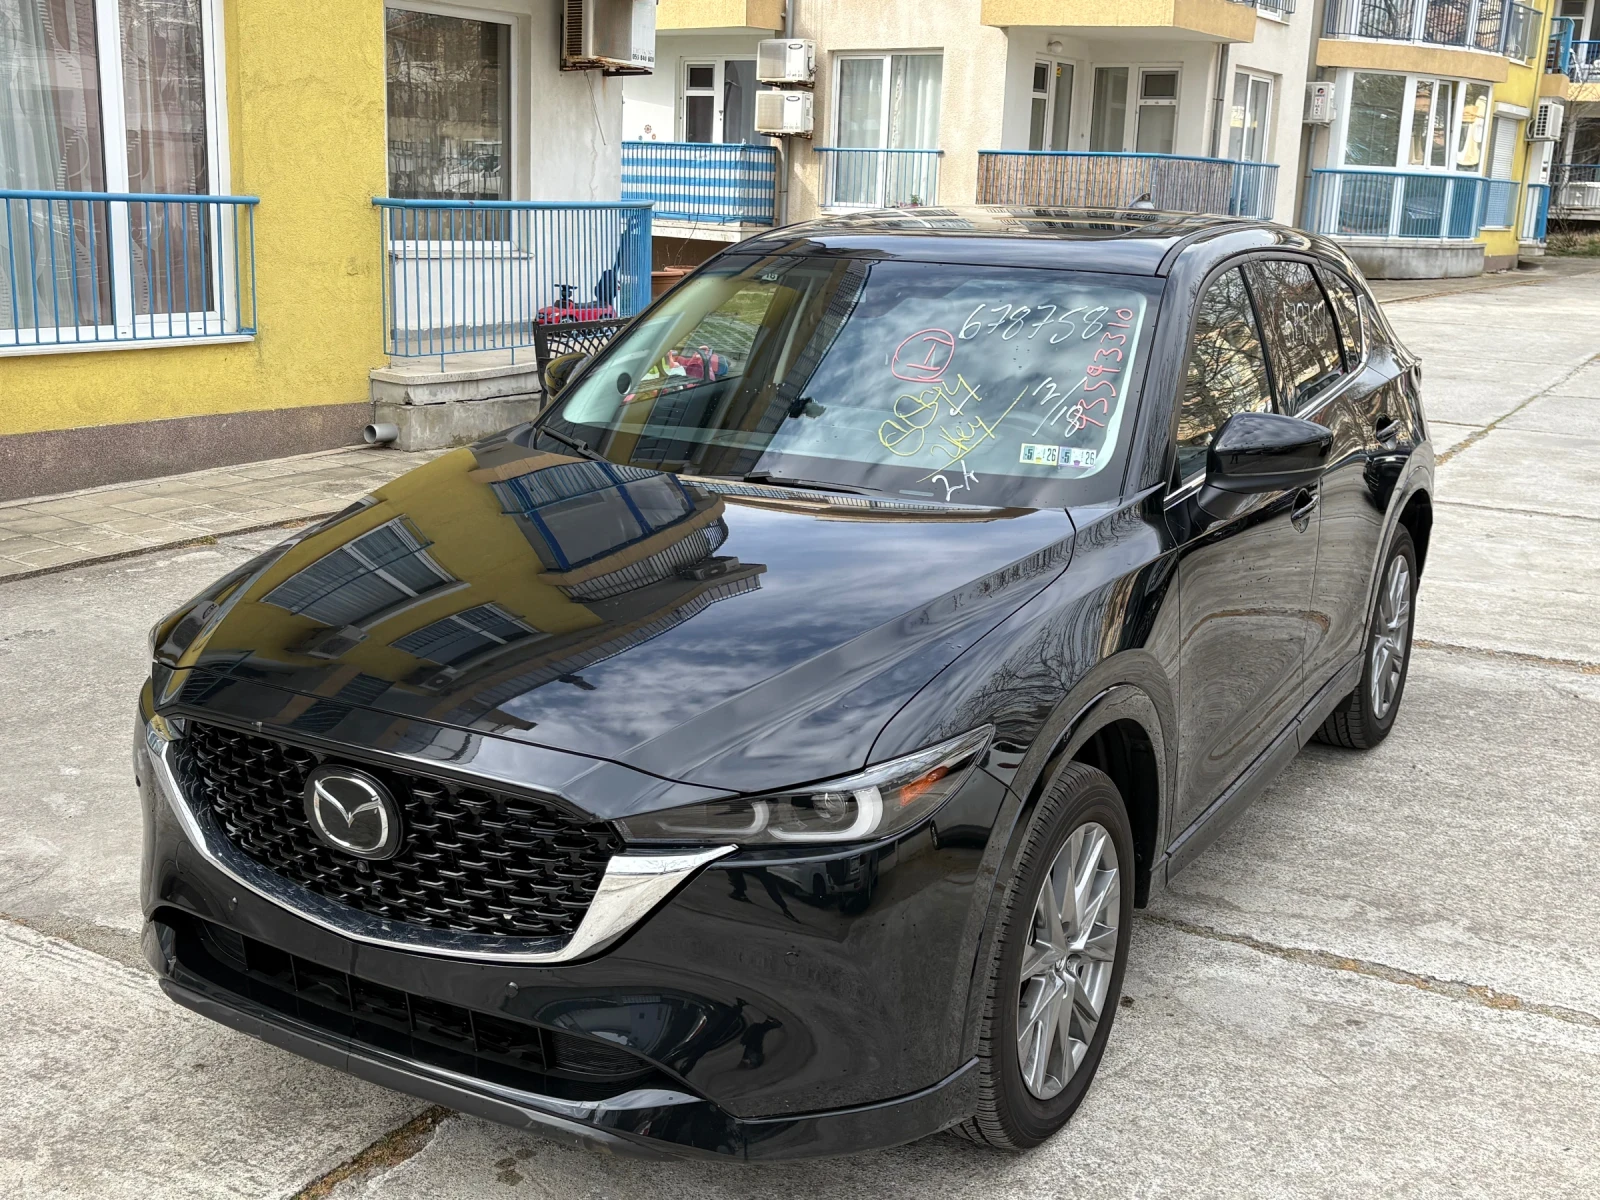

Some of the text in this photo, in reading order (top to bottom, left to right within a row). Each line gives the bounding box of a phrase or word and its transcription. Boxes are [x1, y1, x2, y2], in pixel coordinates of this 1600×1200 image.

[958, 303, 1109, 344] 678758
[1046, 447, 1057, 462] 26
[1085, 451, 1095, 465] 26
